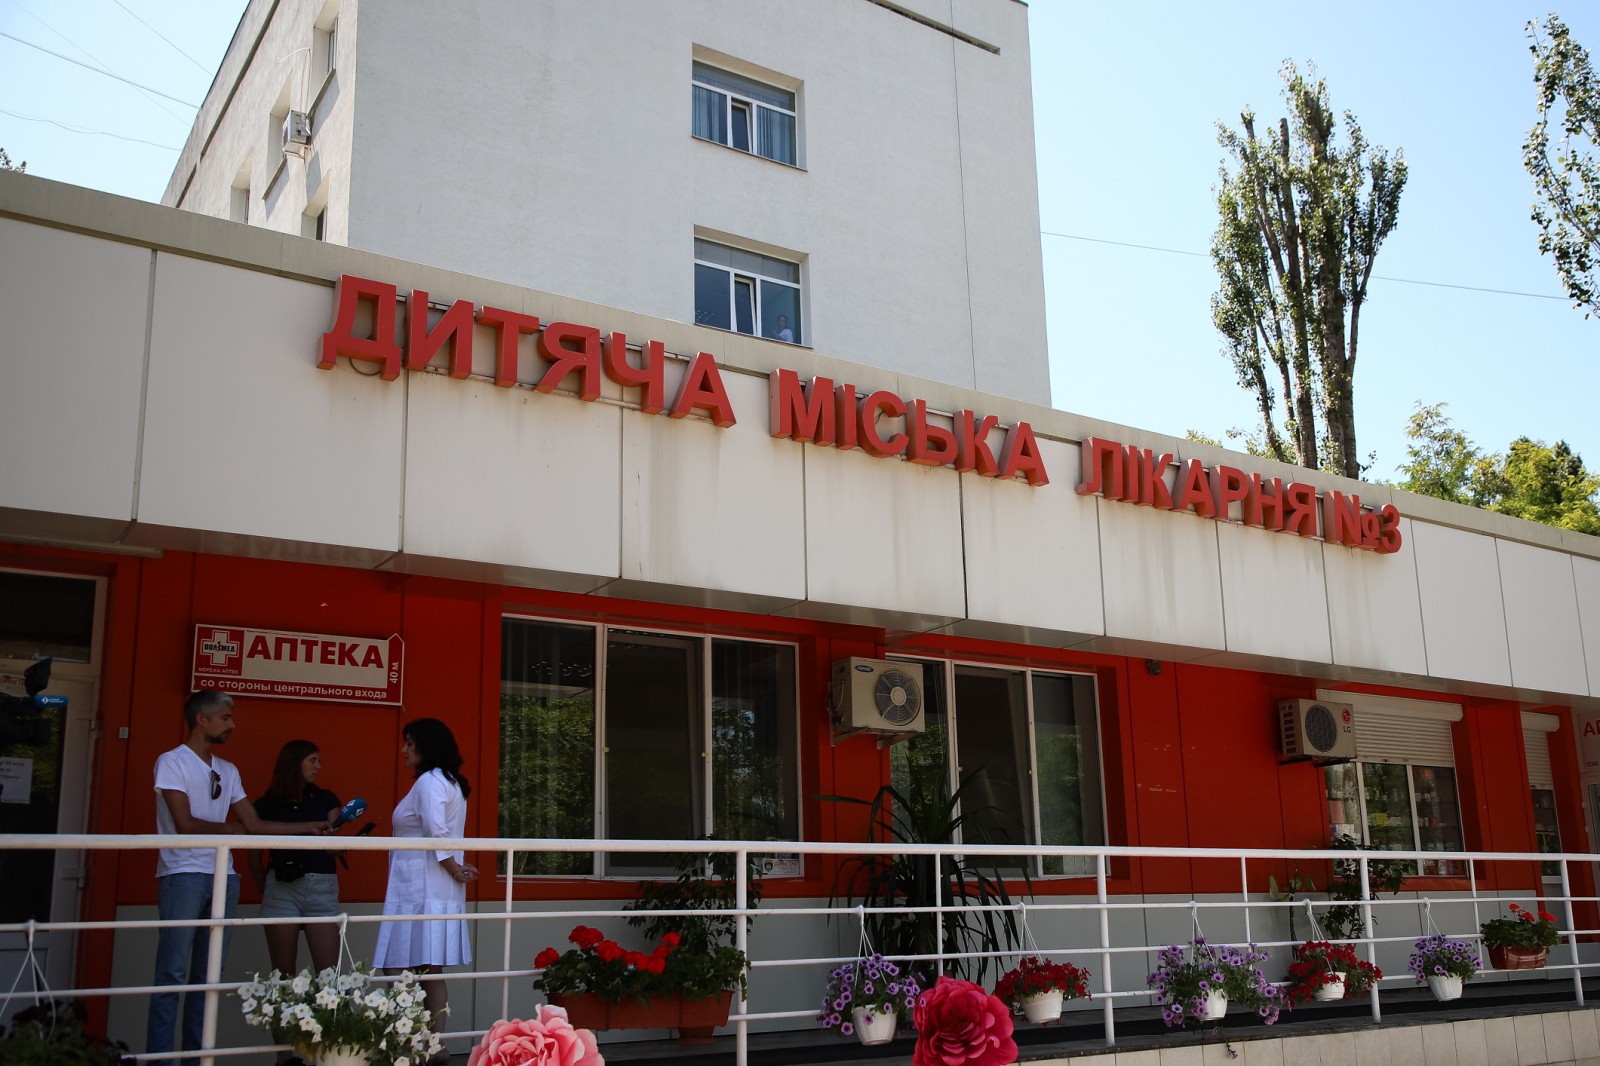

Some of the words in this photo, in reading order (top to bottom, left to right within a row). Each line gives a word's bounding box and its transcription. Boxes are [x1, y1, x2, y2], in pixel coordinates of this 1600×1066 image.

[316, 274, 737, 429] ДИТЯЧА
[769, 368, 1049, 487] МІСЬКА
[1075, 437, 1317, 538] ЛІКАРНЯ
[246, 634, 385, 669] АПТЕКА
[389, 671, 399, 684] 40
[218, 680, 271, 691] стороны
[274, 684, 353, 697] центрального
[355, 689, 387, 699] входа
[1343, 725, 1352, 733] LG
